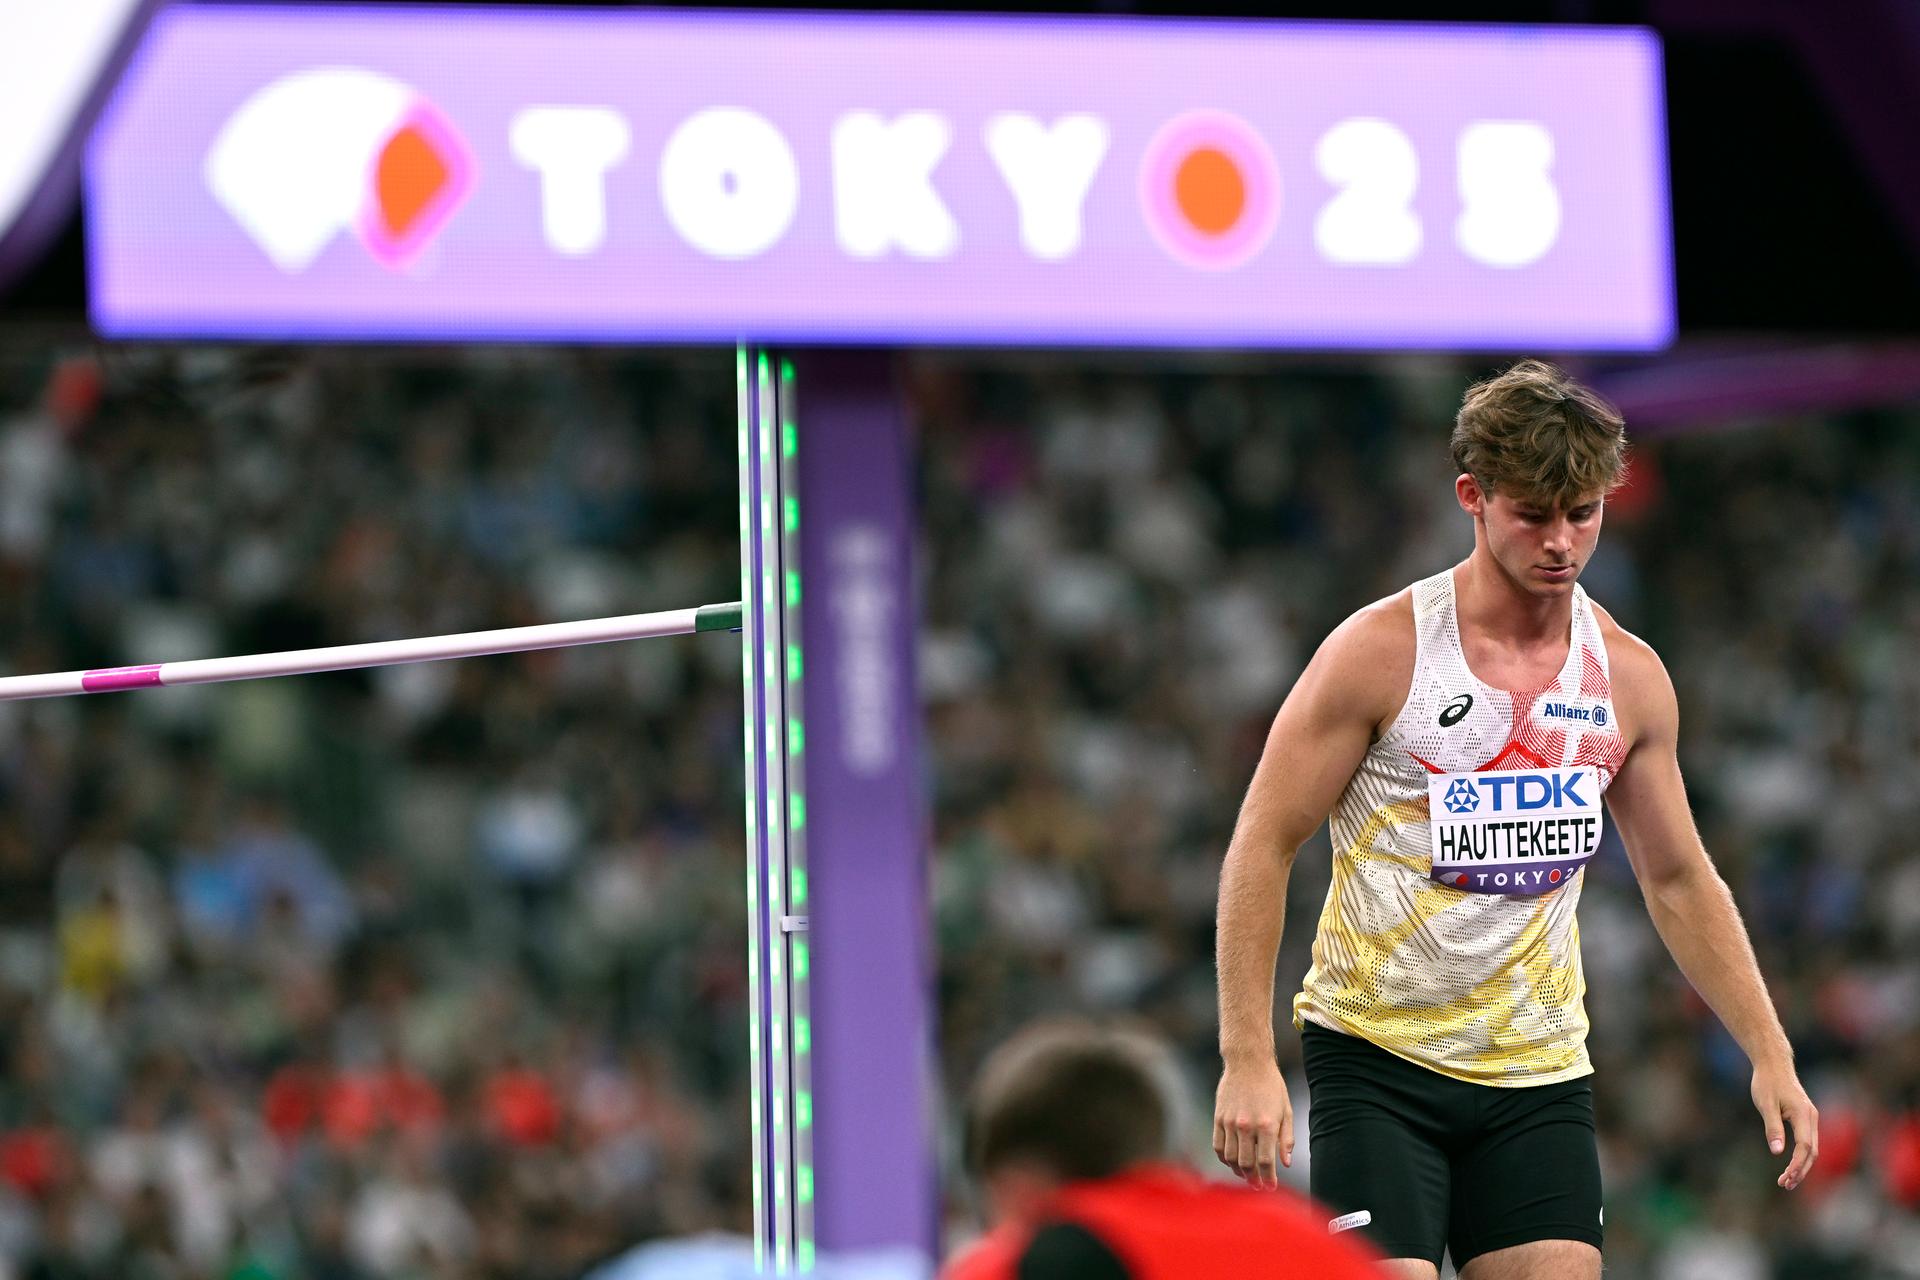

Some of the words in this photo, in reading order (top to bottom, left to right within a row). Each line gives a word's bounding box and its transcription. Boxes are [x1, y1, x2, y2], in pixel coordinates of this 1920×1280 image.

[1544, 703, 1590, 721] Allianz
[1478, 772, 1588, 811] TDK
[1440, 817, 1596, 862] HAUTTEKEETE
